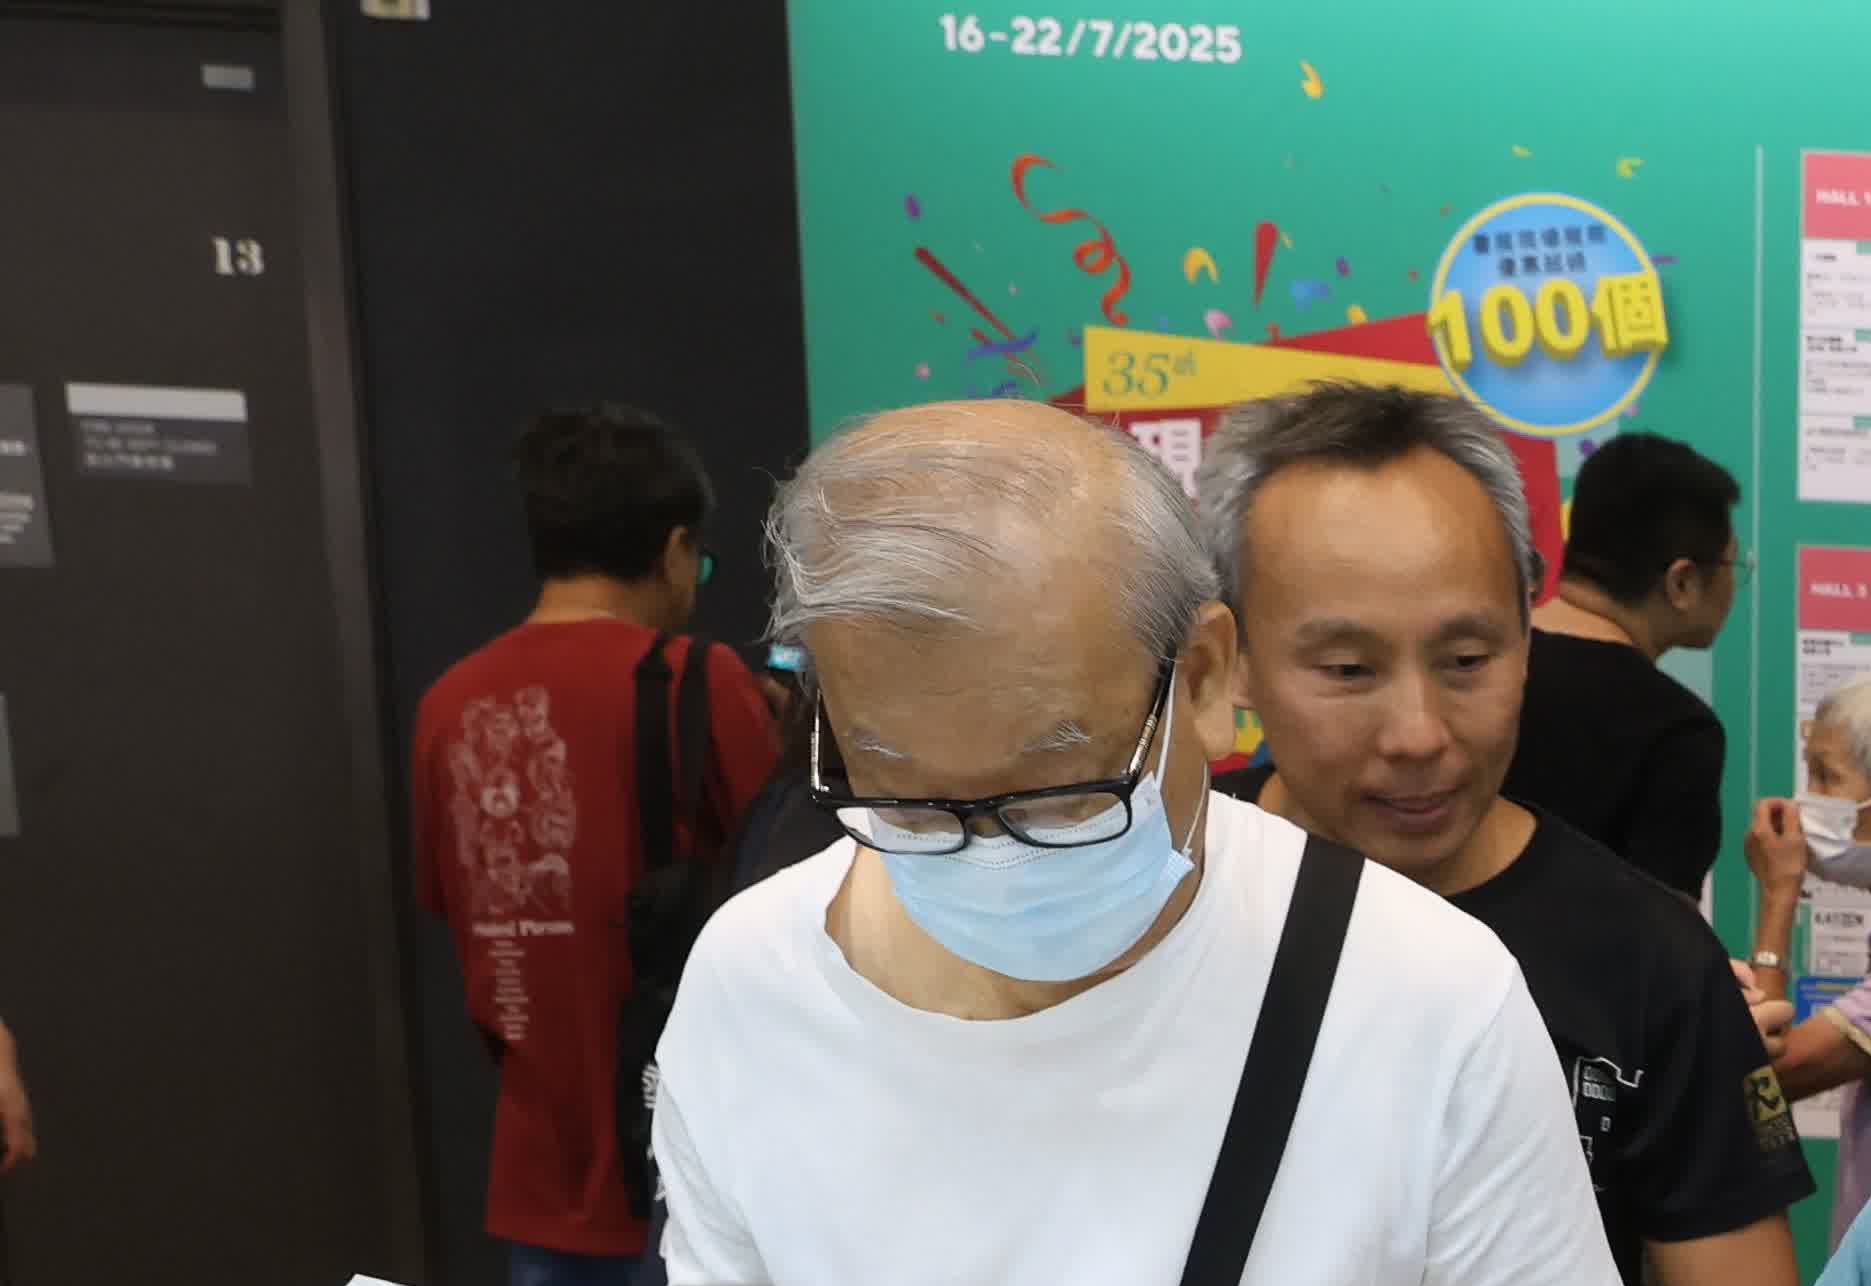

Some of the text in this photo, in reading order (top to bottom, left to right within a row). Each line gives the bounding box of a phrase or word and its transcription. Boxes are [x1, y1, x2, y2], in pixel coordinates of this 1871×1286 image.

[938, 11, 1244, 64] 16-22/7/2025
[212, 237, 265, 275] 13
[1428, 270, 1669, 373] 100個
